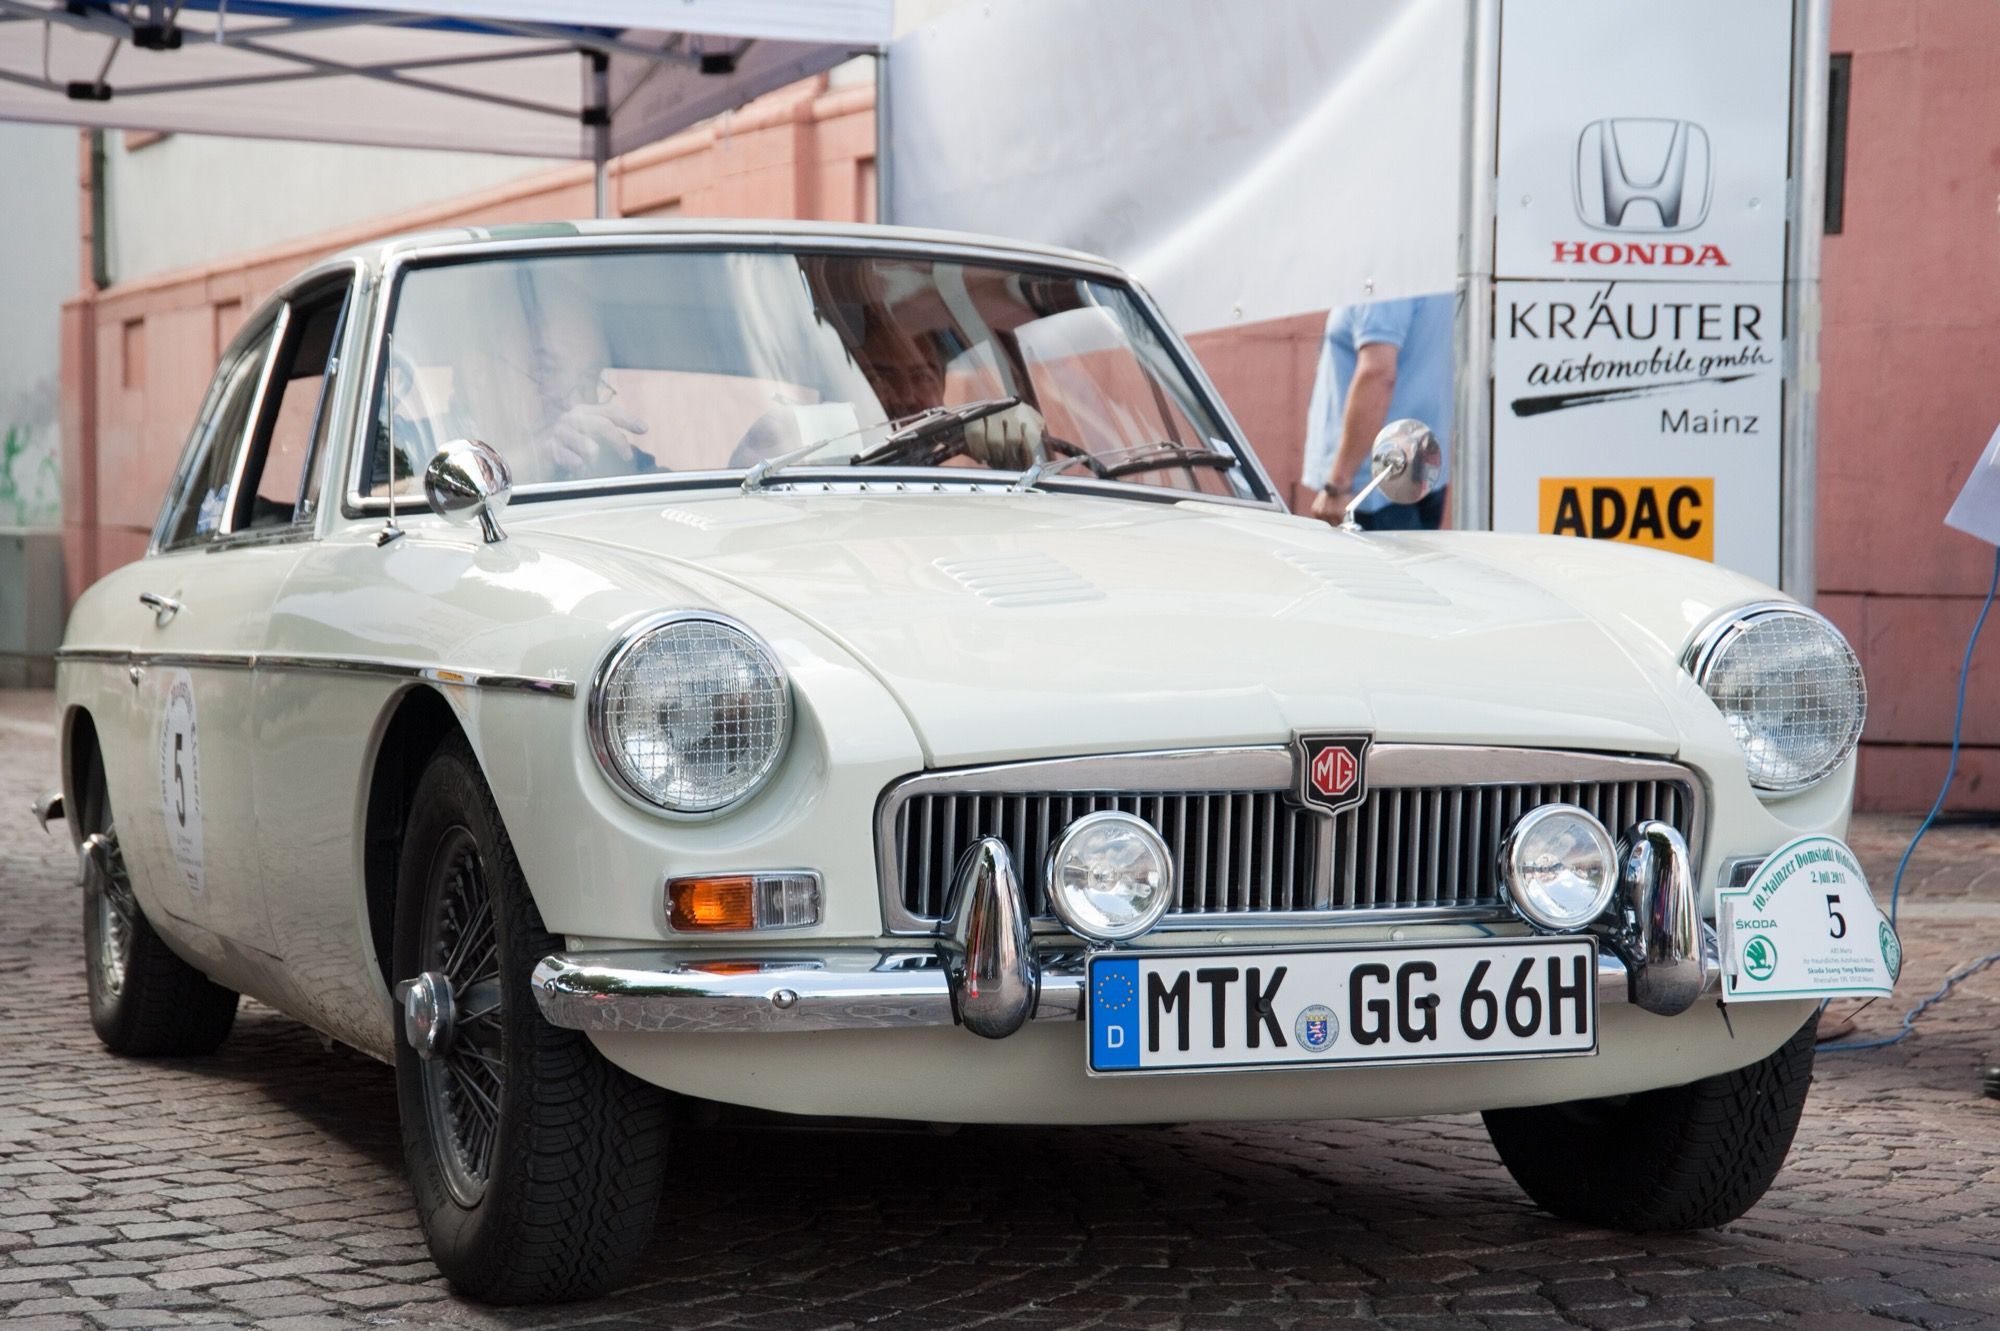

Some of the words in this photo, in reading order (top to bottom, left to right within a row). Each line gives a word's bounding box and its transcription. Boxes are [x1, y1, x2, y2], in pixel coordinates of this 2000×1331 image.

[1552, 241, 1730, 267] HONDA
[1510, 281, 1763, 341] KRÄUTER
[1660, 408, 1759, 434] Mainz
[1552, 485, 1703, 540] ADAC
[174, 732, 185, 828] 5
[1317, 752, 1353, 791] MG
[1752, 893, 1769, 913] 10.
[1762, 860, 1796, 895] Mainzer
[1794, 846, 1835, 869] Domstadt
[1811, 871, 1820, 884] 2.
[1820, 870, 1831, 886] Juli
[1831, 871, 1846, 885] 2011
[1735, 918, 1778, 930] ŠKODA
[1826, 894, 1847, 939] 5
[1147, 966, 1288, 1053] MTK
[1349, 960, 1438, 1046] GG
[1460, 955, 1588, 1041] 66H
[1107, 1025, 1124, 1049] D
